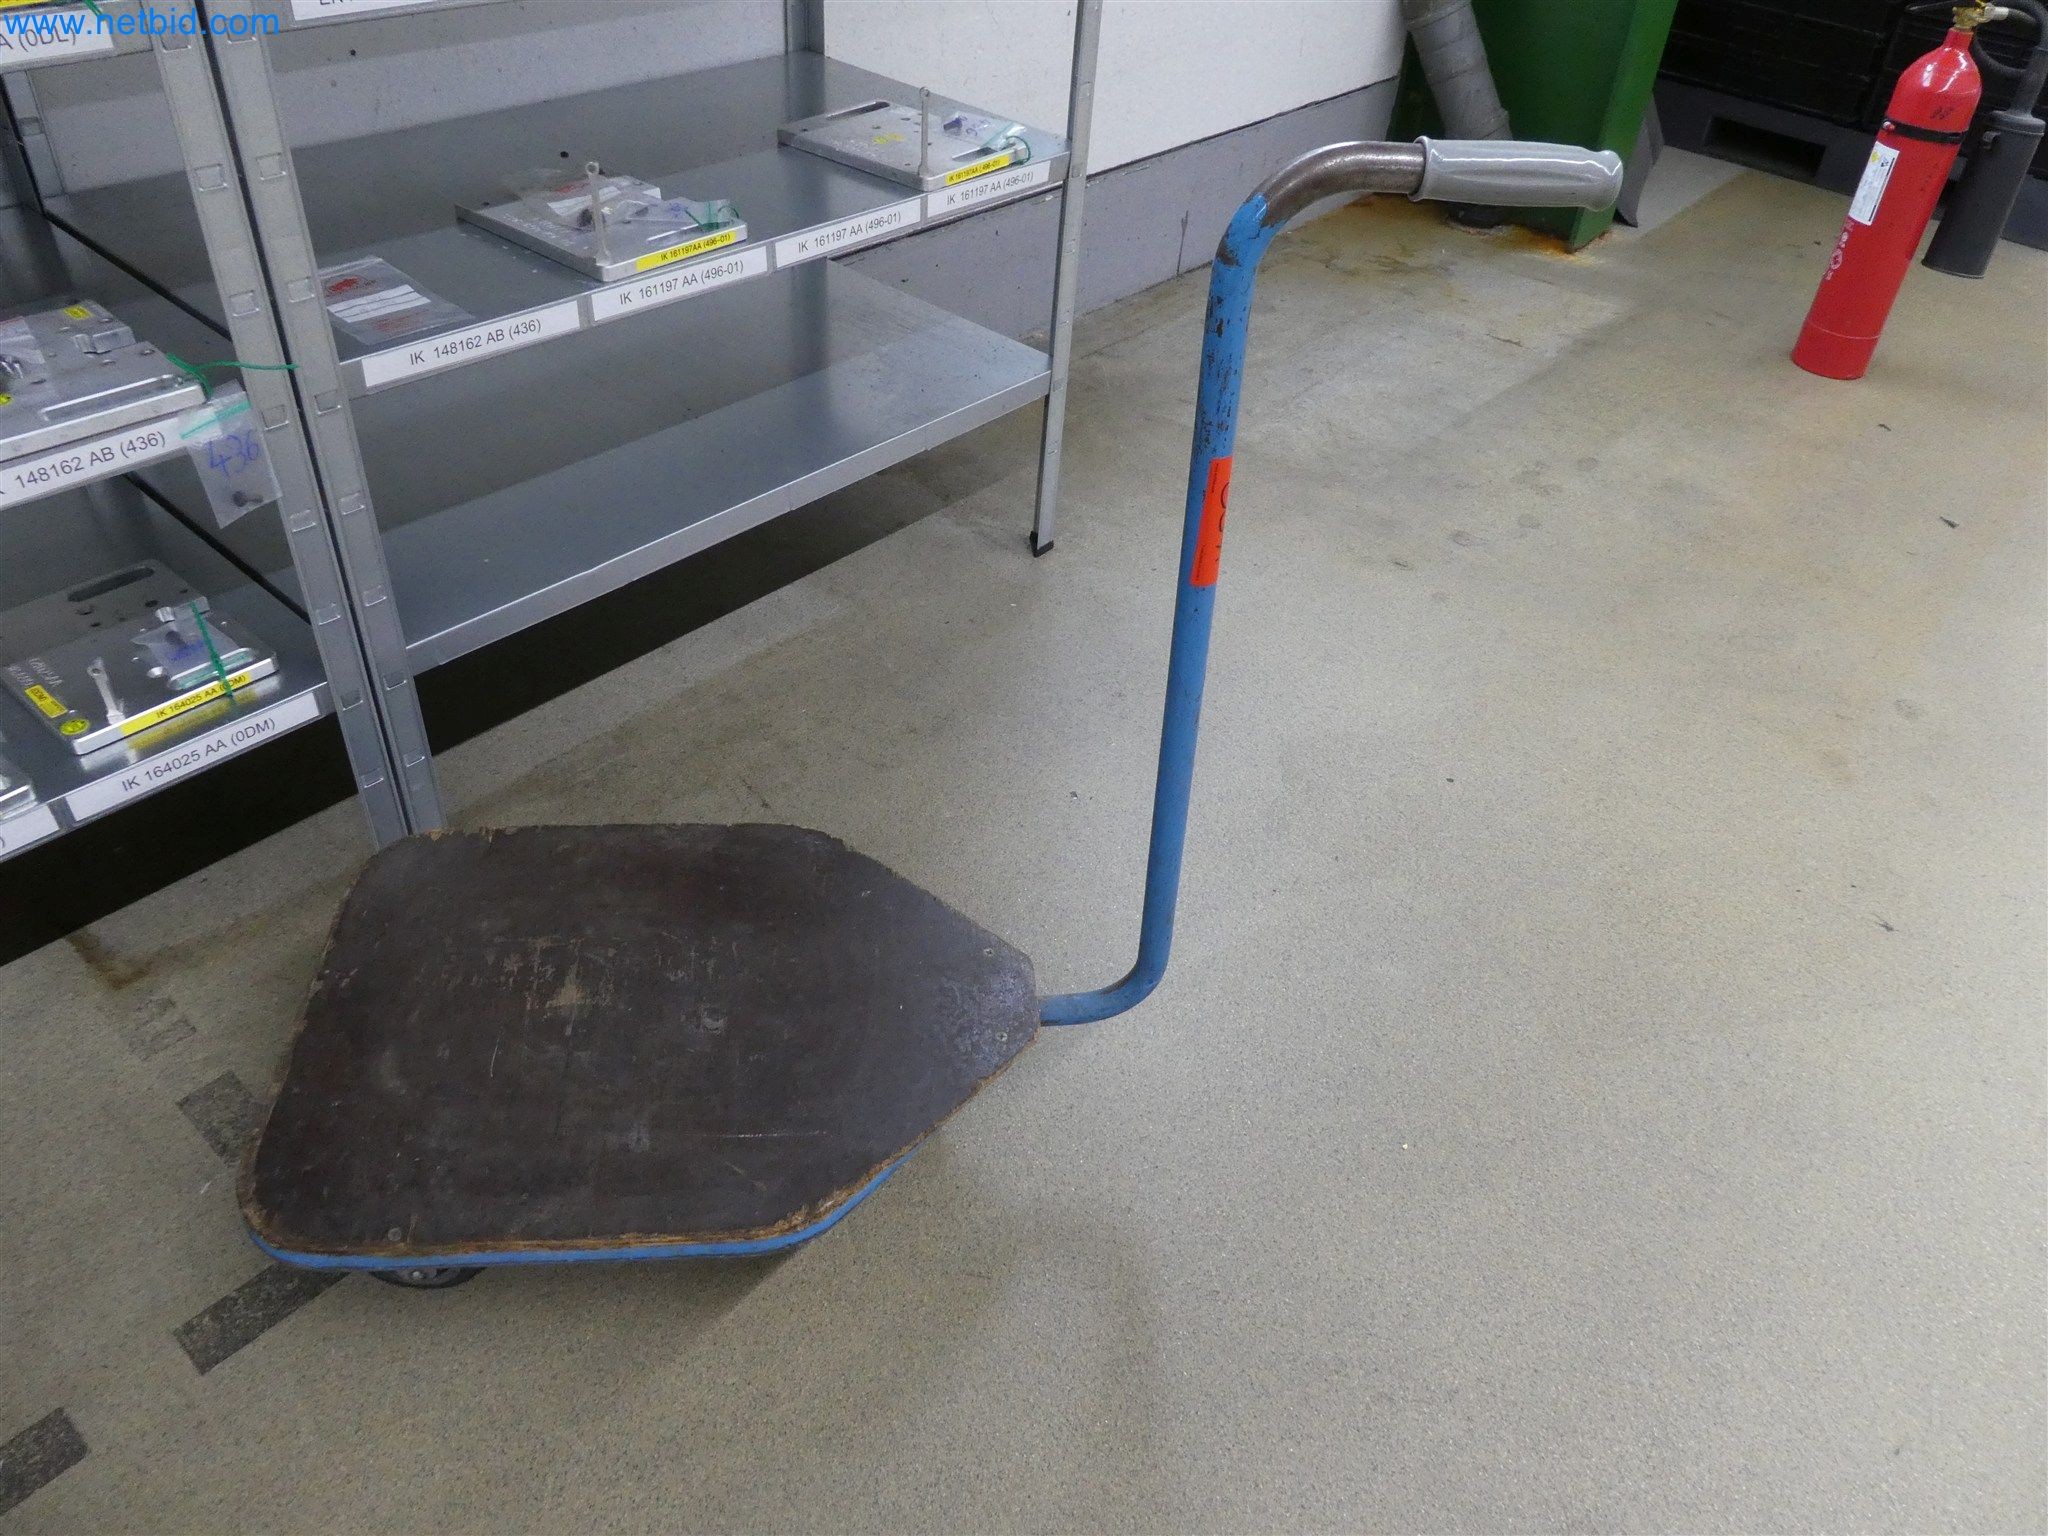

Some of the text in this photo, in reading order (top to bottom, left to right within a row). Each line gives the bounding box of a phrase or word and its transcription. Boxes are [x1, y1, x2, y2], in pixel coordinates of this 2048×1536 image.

[947, 171, 1034, 205] IK 161197 AA (496-01)
[798, 212, 902, 253] IK 161197 AA (496-01)
[660, 253, 669, 261] IK
[619, 260, 744, 305] IK 161197 AA (496-01)
[409, 318, 542, 366] IK 148162 AB (436)
[14, 431, 166, 489] 148162 AB (436)
[156, 710, 168, 720] IK
[121, 717, 276, 792] IK 164025 AA (0DM)
